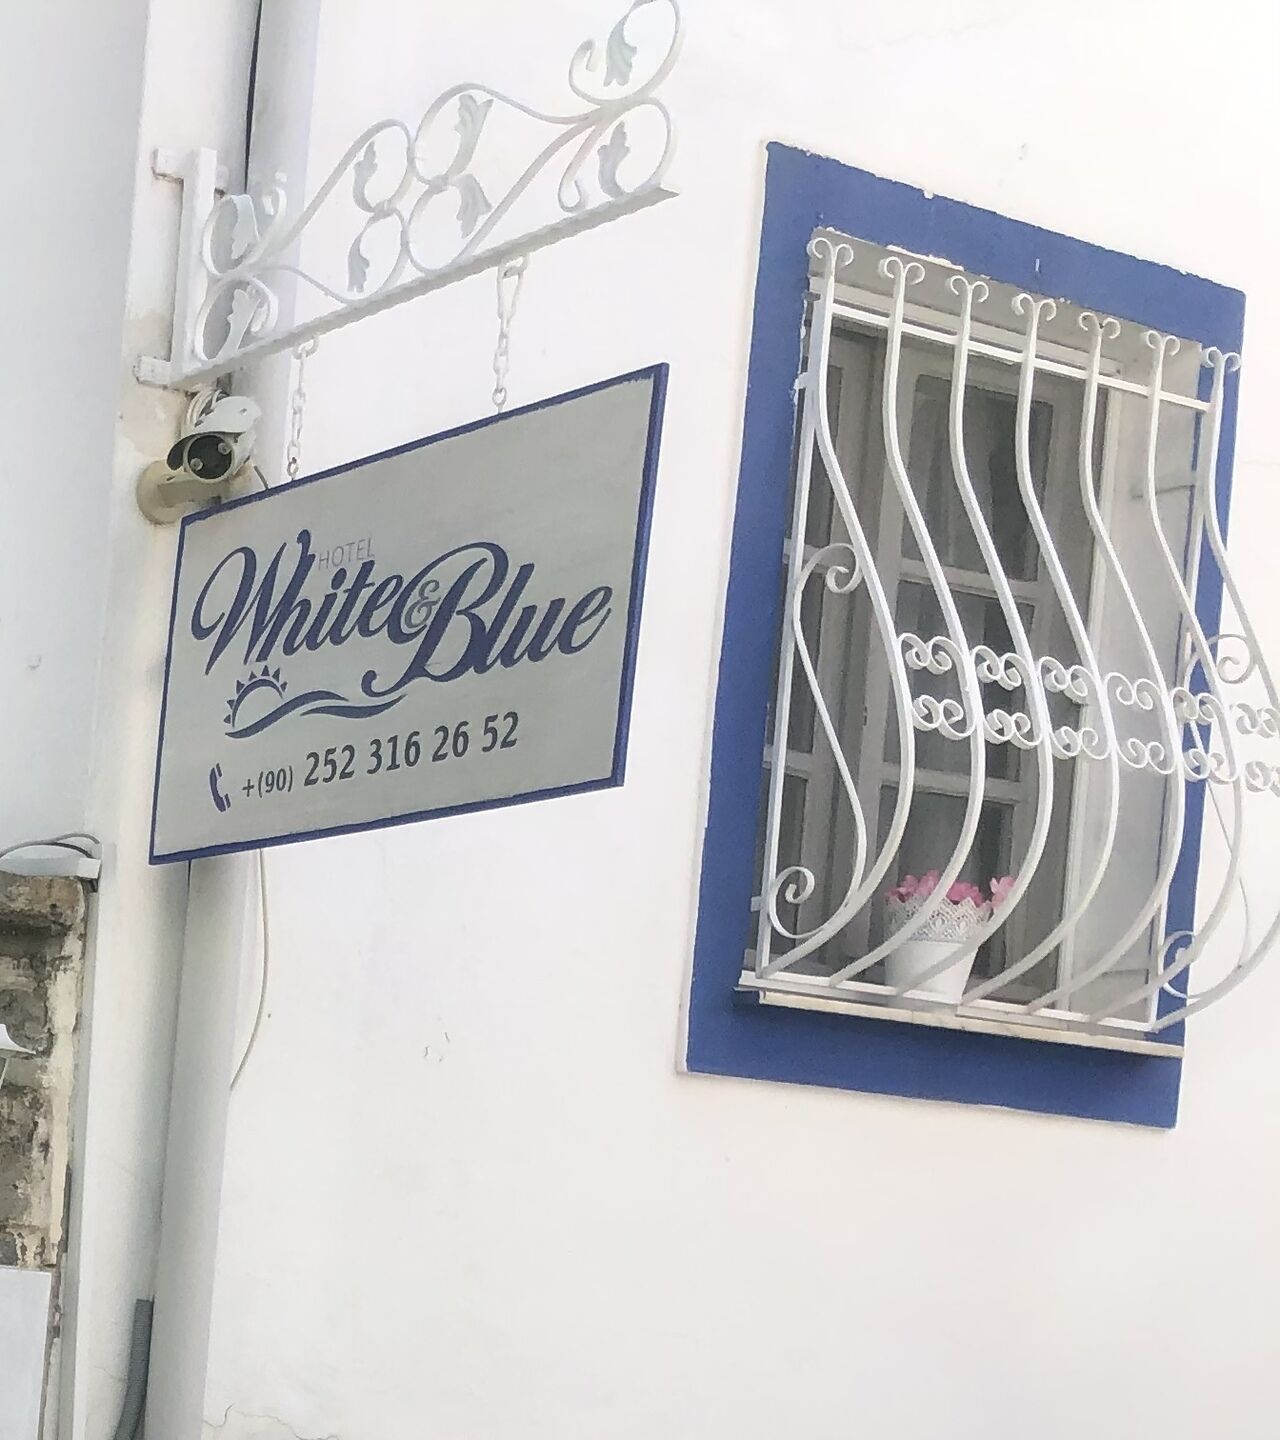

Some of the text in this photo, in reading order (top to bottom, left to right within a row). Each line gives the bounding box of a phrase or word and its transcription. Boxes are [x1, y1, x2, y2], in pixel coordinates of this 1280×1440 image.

[318, 537, 375, 570] HOTEL
[191, 529, 612, 697] White & Blue
[242, 711, 519, 798] +(90) 252 316 26 52
